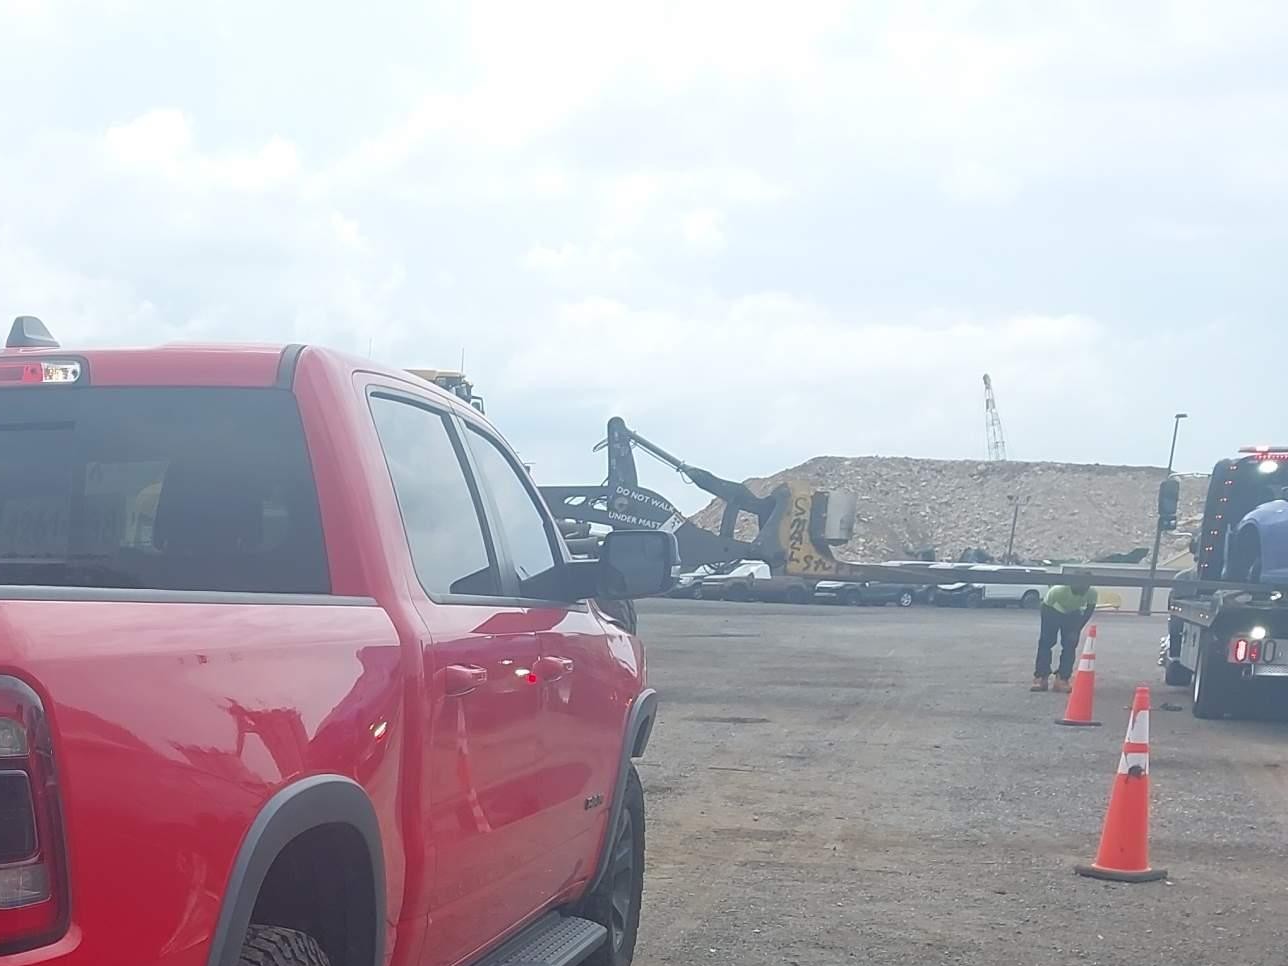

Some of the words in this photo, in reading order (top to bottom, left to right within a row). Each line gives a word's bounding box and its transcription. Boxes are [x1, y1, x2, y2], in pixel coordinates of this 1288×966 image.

[616, 486, 630, 496] DO
[631, 491, 650, 503] NOT
[652, 498, 675, 513] WALK
[608, 511, 637, 525] UNDER
[638, 518, 662, 529] MAST
